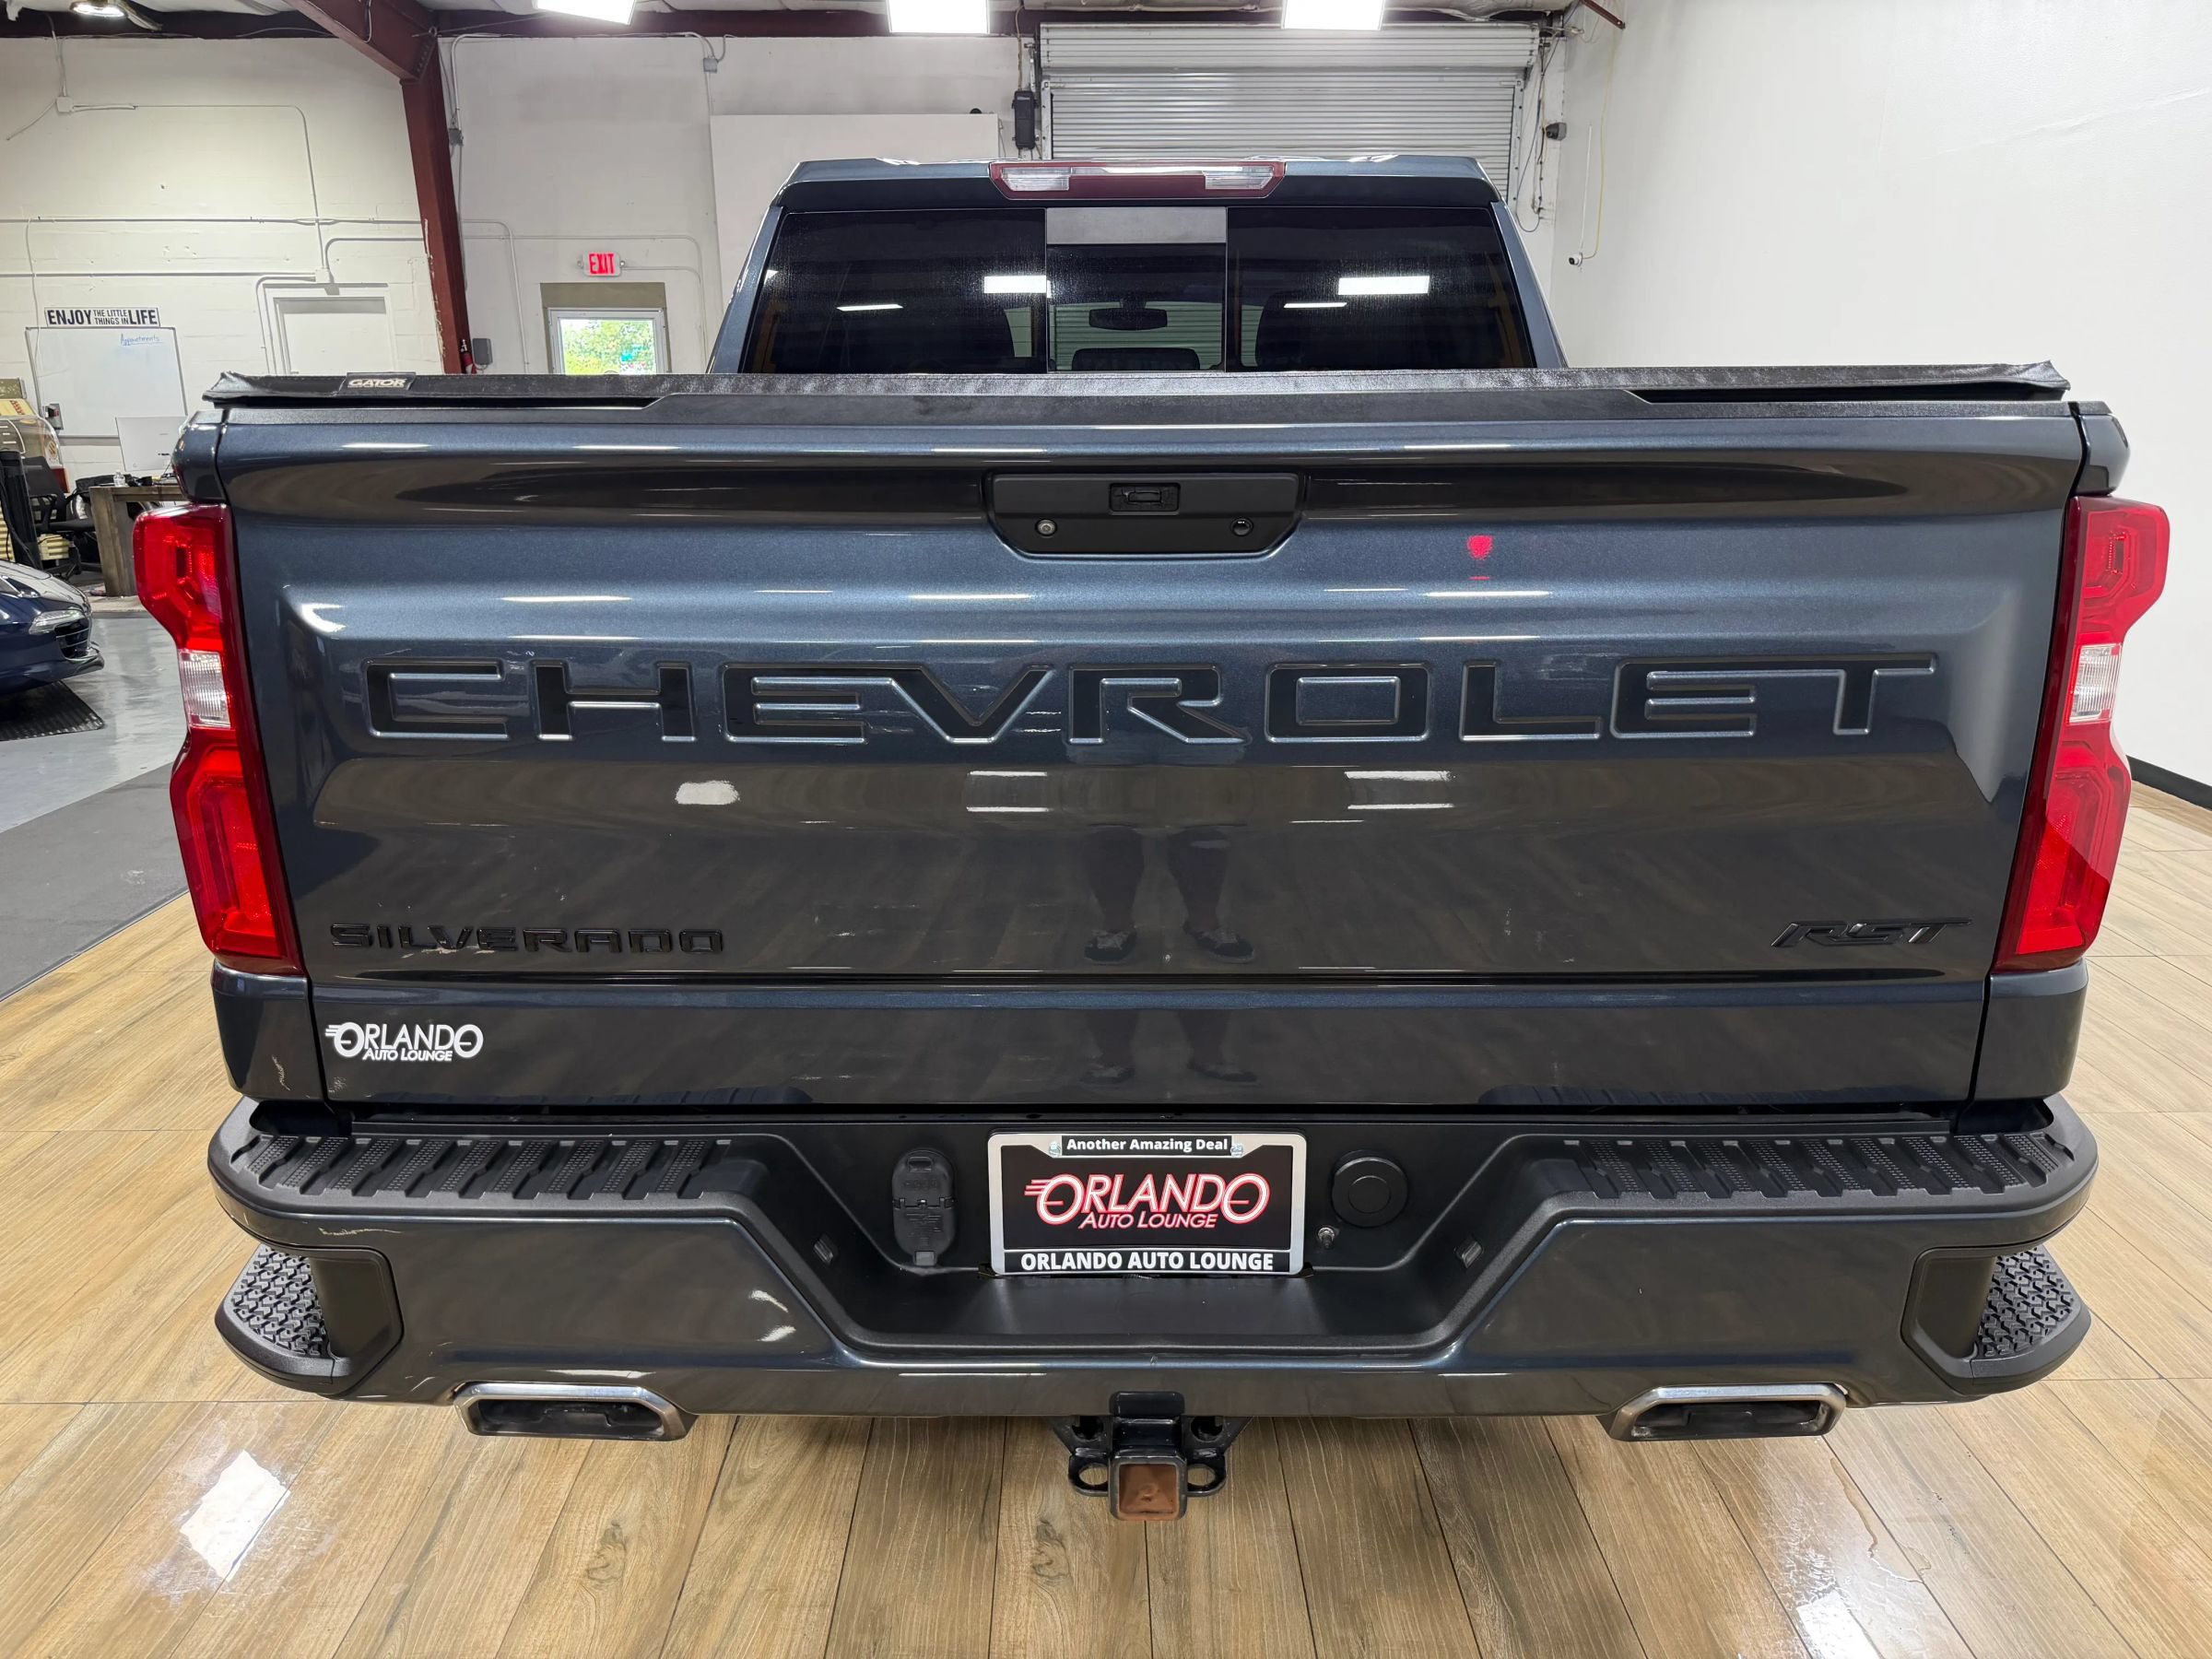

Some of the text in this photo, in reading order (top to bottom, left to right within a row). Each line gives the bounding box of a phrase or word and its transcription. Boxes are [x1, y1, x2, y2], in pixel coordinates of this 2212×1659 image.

[588, 253, 615, 275] EXIT
[46, 309, 91, 325] ENJOY
[93, 309, 127, 317] THE LITTLE
[94, 317, 130, 325] THINGS IN
[127, 309, 158, 325] LIFE
[348, 378, 407, 388] GATOR
[363, 652, 1939, 747] CHEVROLET
[329, 923, 724, 954] SILVERADO
[1771, 917, 1973, 948] RST
[326, 1021, 484, 1059] ORLANDO
[362, 1049, 453, 1062] AUTO LOUNGE
[1066, 1138, 1229, 1152] Another Amazing Deal
[1025, 1172, 1271, 1225] ORLANDO
[1077, 1211, 1218, 1230] AUTO LOUNGE
[1020, 1251, 1274, 1271] ORLANDO AUTO LOUNGE
